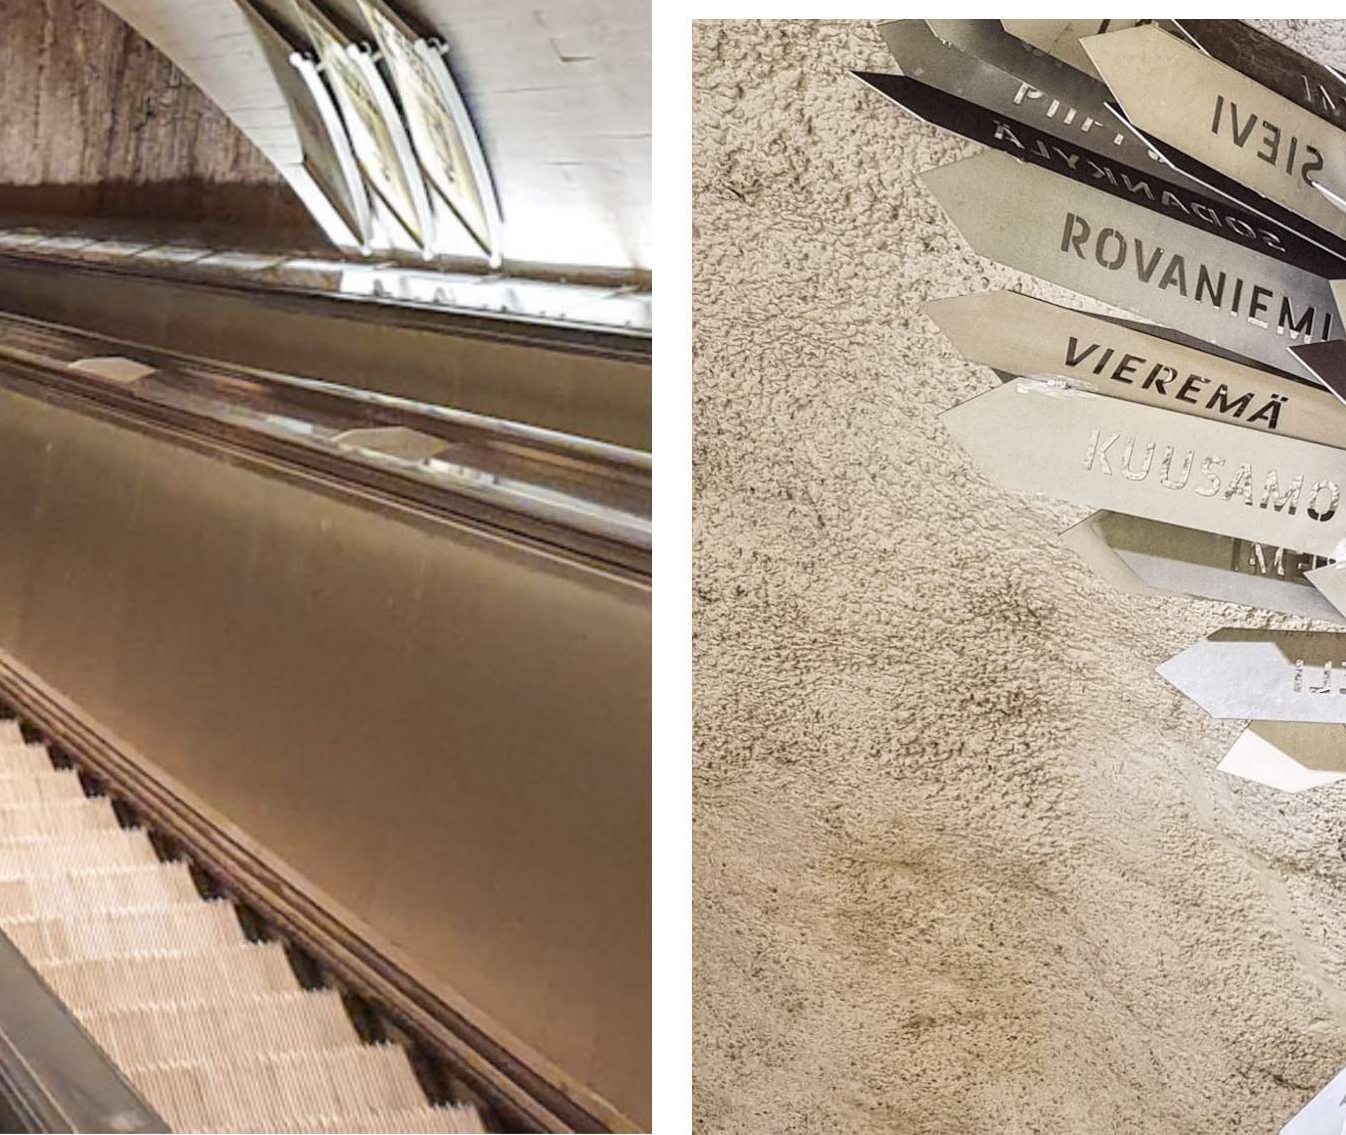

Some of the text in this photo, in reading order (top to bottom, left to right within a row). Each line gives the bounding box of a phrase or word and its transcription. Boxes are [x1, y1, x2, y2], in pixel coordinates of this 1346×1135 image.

[1061, 211, 1335, 344] ROVANIEMI
[1064, 336, 1290, 432] VIEREMÄ
[1081, 426, 1344, 524] KUUSAMO
